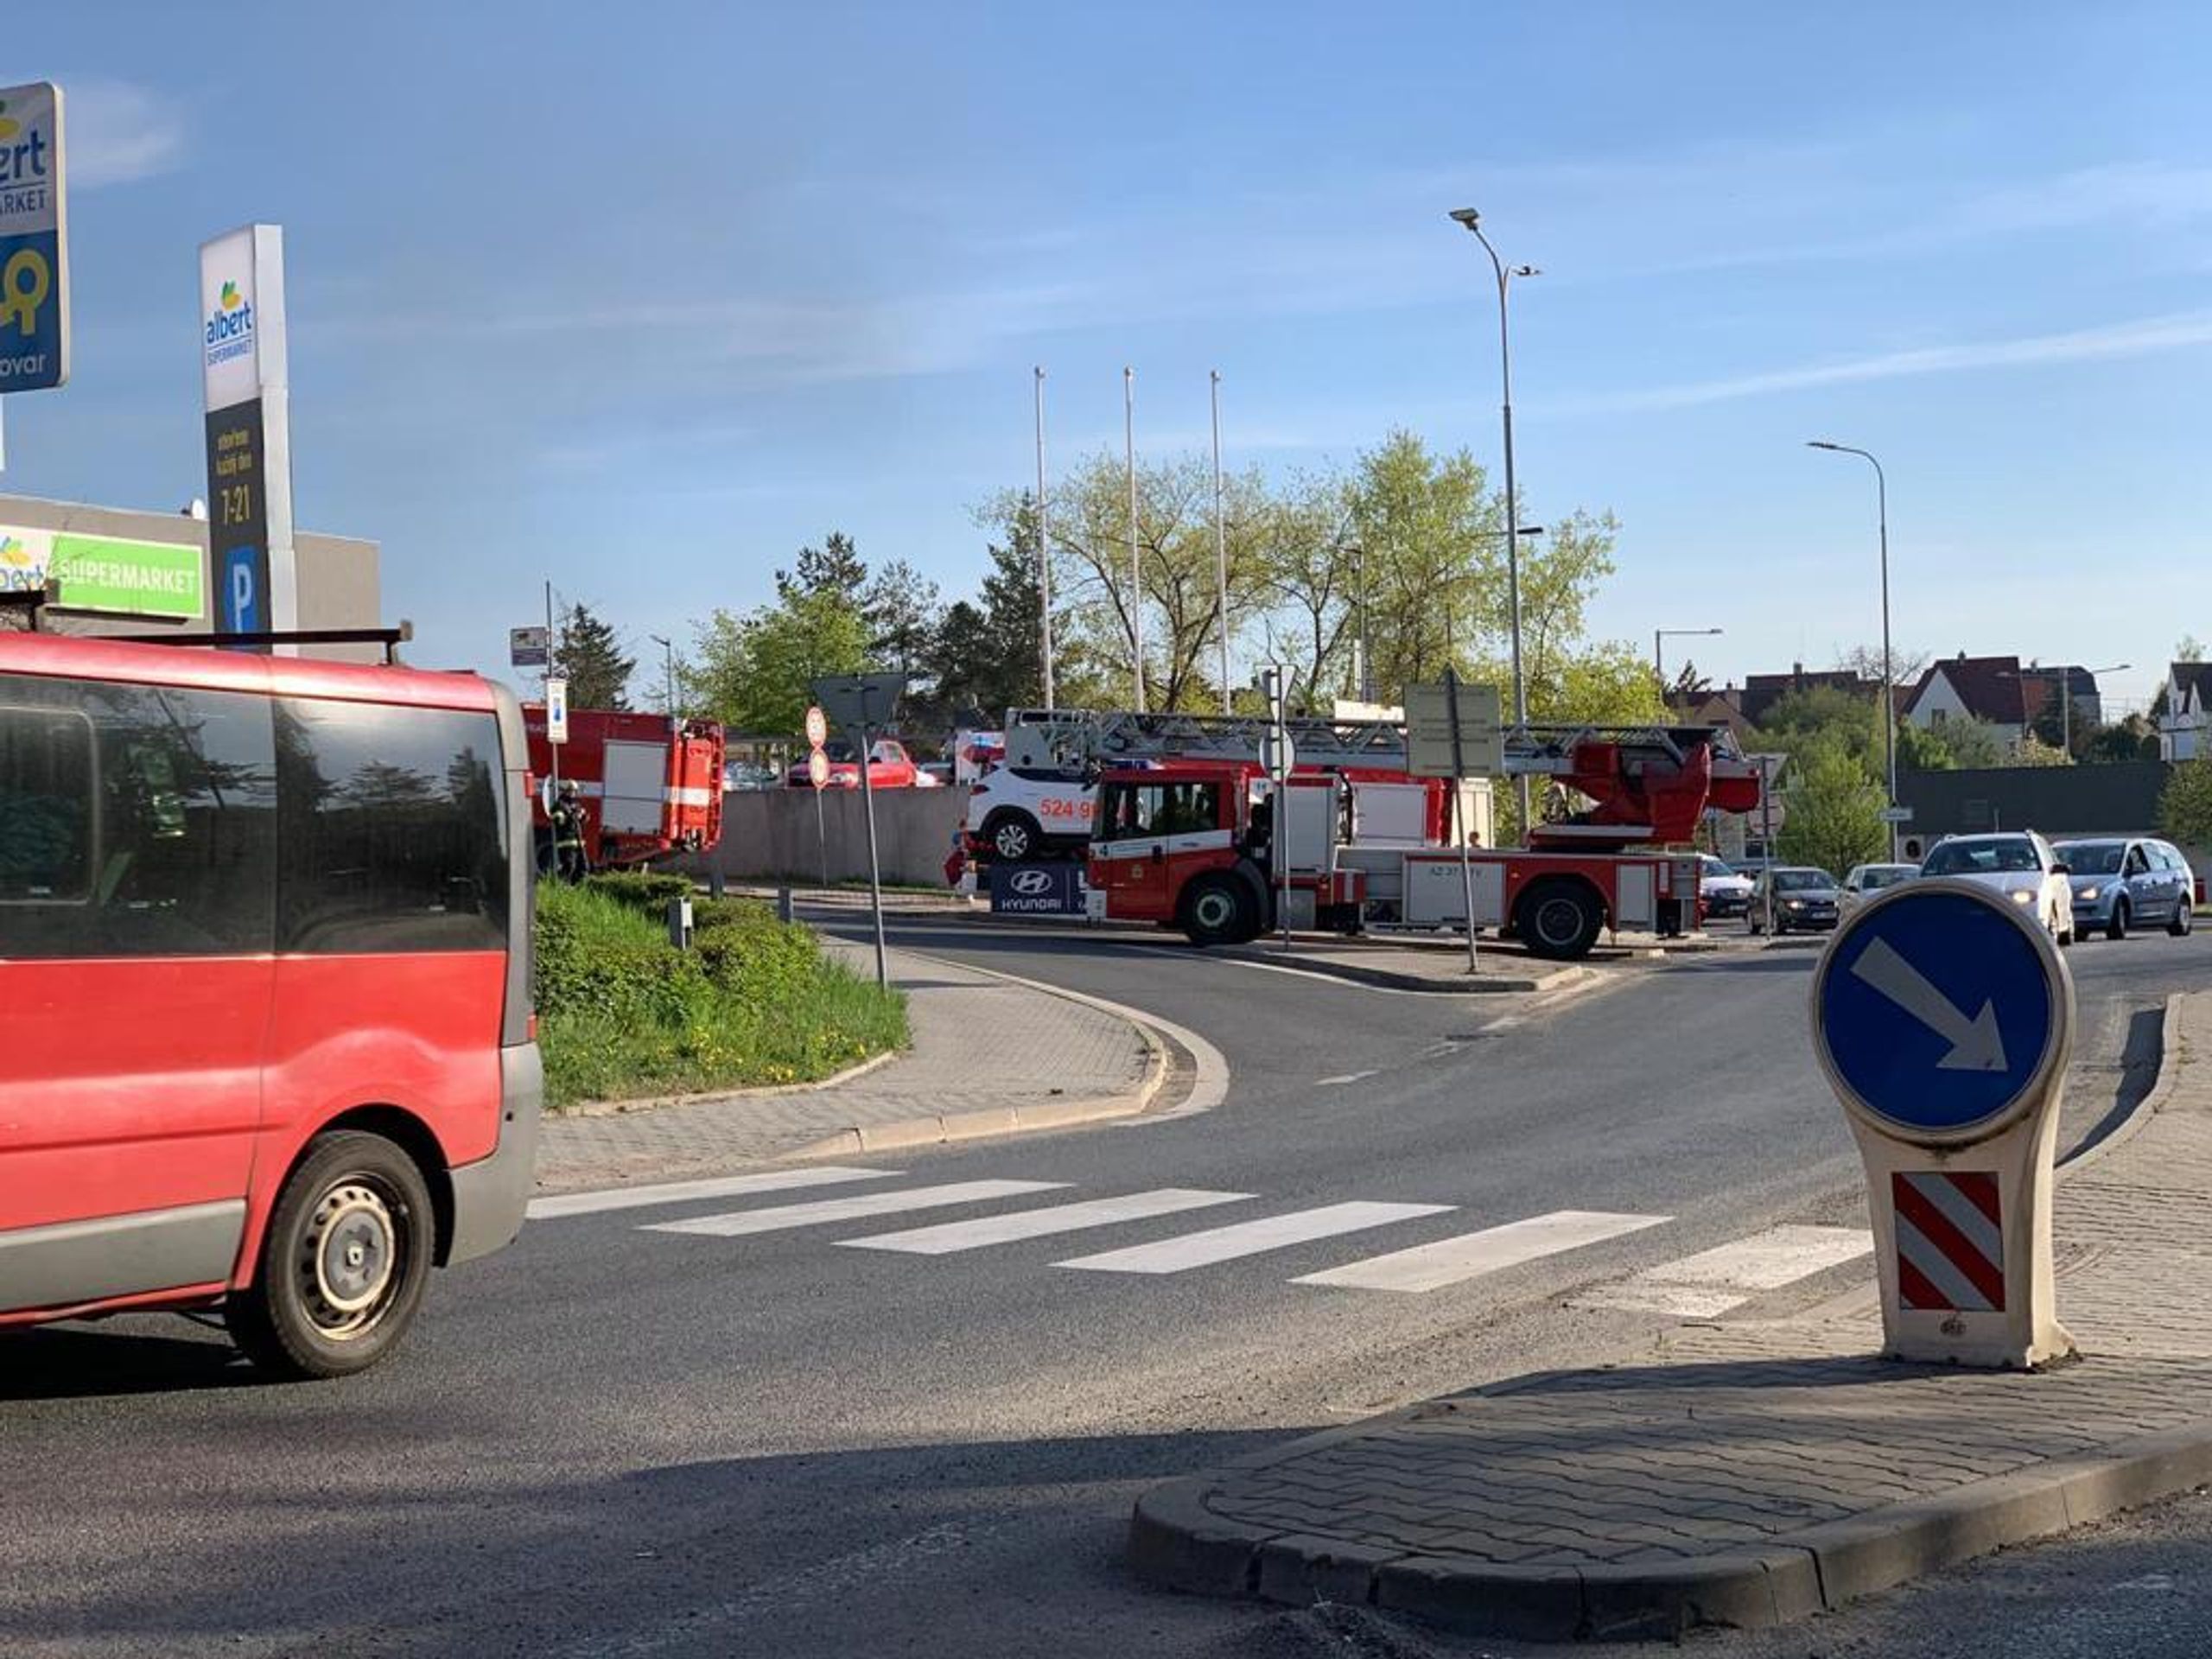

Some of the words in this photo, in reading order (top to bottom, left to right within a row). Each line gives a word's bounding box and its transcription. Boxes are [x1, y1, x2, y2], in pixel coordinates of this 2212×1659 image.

[207, 300, 251, 344] albert
[221, 484, 250, 525] 7-21
[59, 560, 195, 595] SUPERMARKET
[232, 563, 252, 633] P
[1040, 798, 1073, 817] 524
[1002, 898, 1063, 911] HYUNDAI
